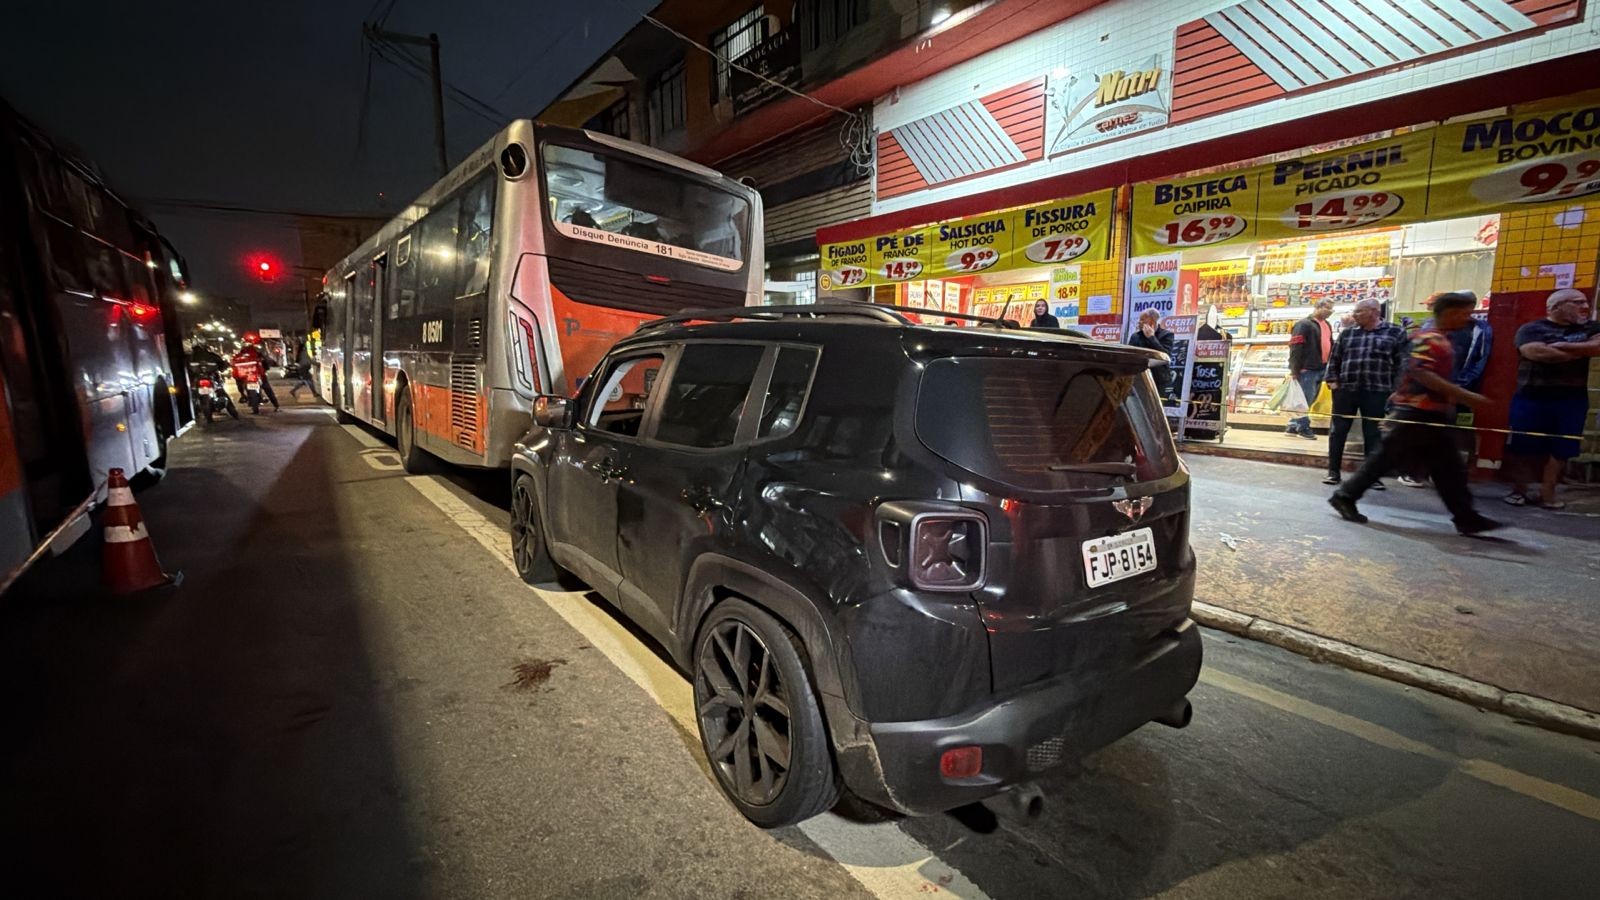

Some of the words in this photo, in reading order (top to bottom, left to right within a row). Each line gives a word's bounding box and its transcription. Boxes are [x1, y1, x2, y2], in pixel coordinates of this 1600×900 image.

[1095, 68, 1162, 108] Nutri
[1273, 145, 1408, 186] PERNIL
[1155, 175, 1248, 206] BISTECA
[1295, 172, 1381, 197] PICADO
[1025, 202, 1096, 227] FISSURA
[1173, 196, 1231, 215] CAIPIRA
[939, 219, 1006, 241] SALSICHA
[1032, 226, 1046, 237] DE
[1050, 219, 1089, 236] PORCO
[572, 227, 604, 241] Disque
[608, 234, 648, 250] Denúncia
[655, 245, 673, 255] 181
[877, 235, 898, 252] PÉ
[904, 233, 924, 247] DE
[950, 237, 970, 249] HOT
[972, 235, 994, 247] DOG
[831, 259, 839, 267] DE
[840, 254, 867, 265] FRANGO
[883, 247, 919, 259] FRANGO
[1135, 263, 1146, 274] KIT
[1147, 259, 1178, 273] FEIJOADA
[1165, 318, 1196, 327] OFERTA
